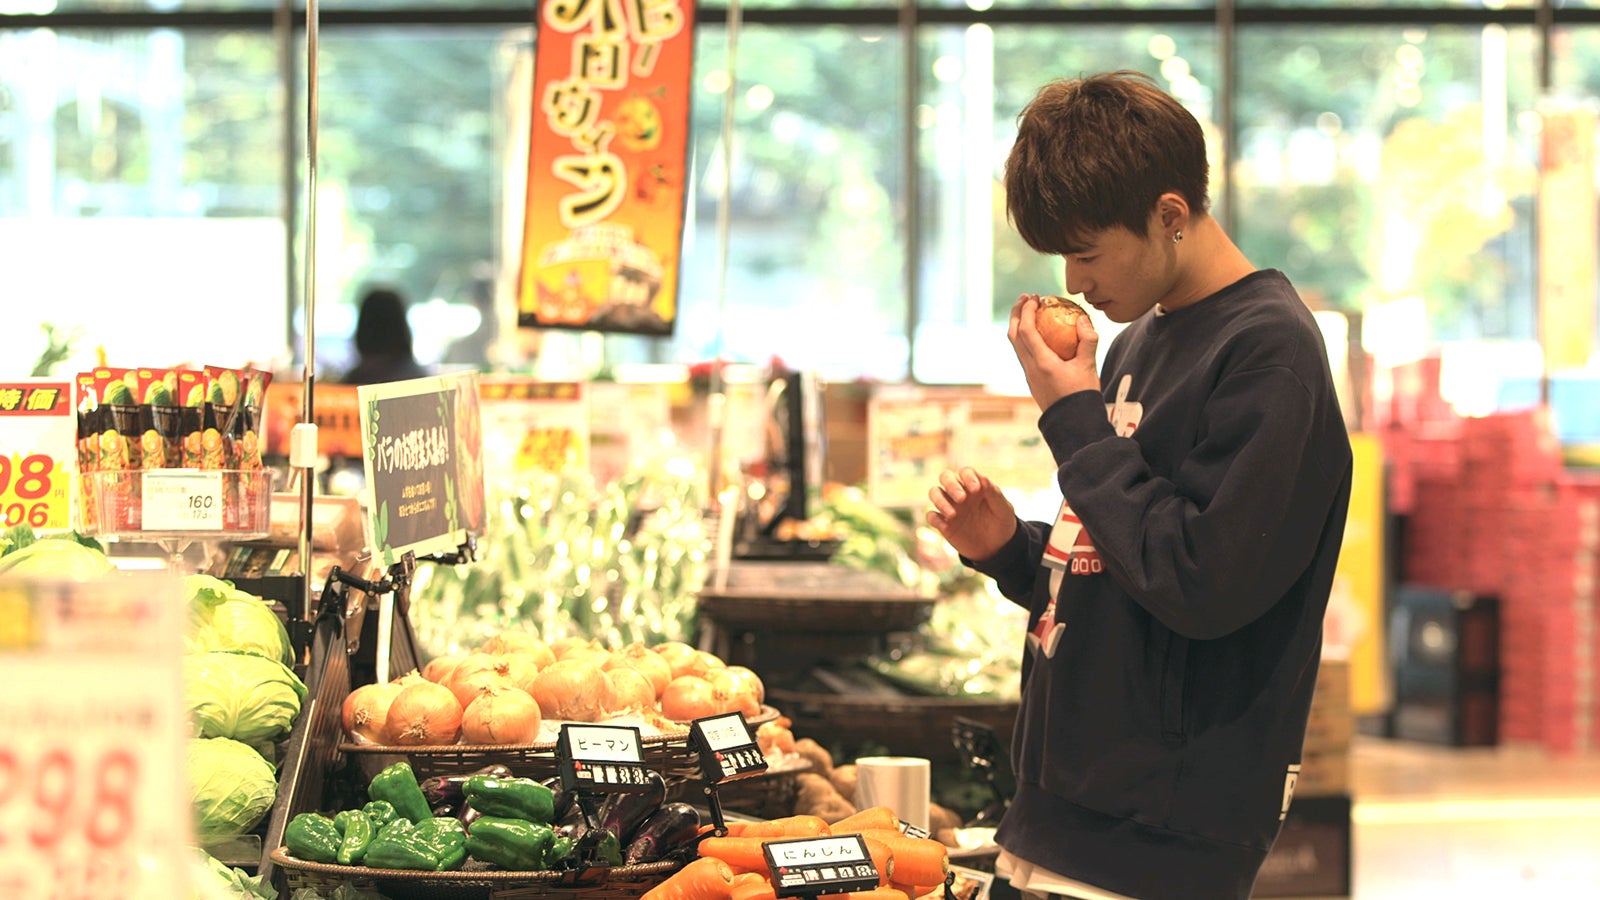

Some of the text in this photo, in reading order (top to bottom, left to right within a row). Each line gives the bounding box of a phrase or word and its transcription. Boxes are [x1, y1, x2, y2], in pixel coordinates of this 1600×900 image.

[0, 388, 58, 411] 特価
[188, 495, 213, 508] 160
[578, 738, 629, 752] ピーマン
[783, 845, 852, 860] にんじん
